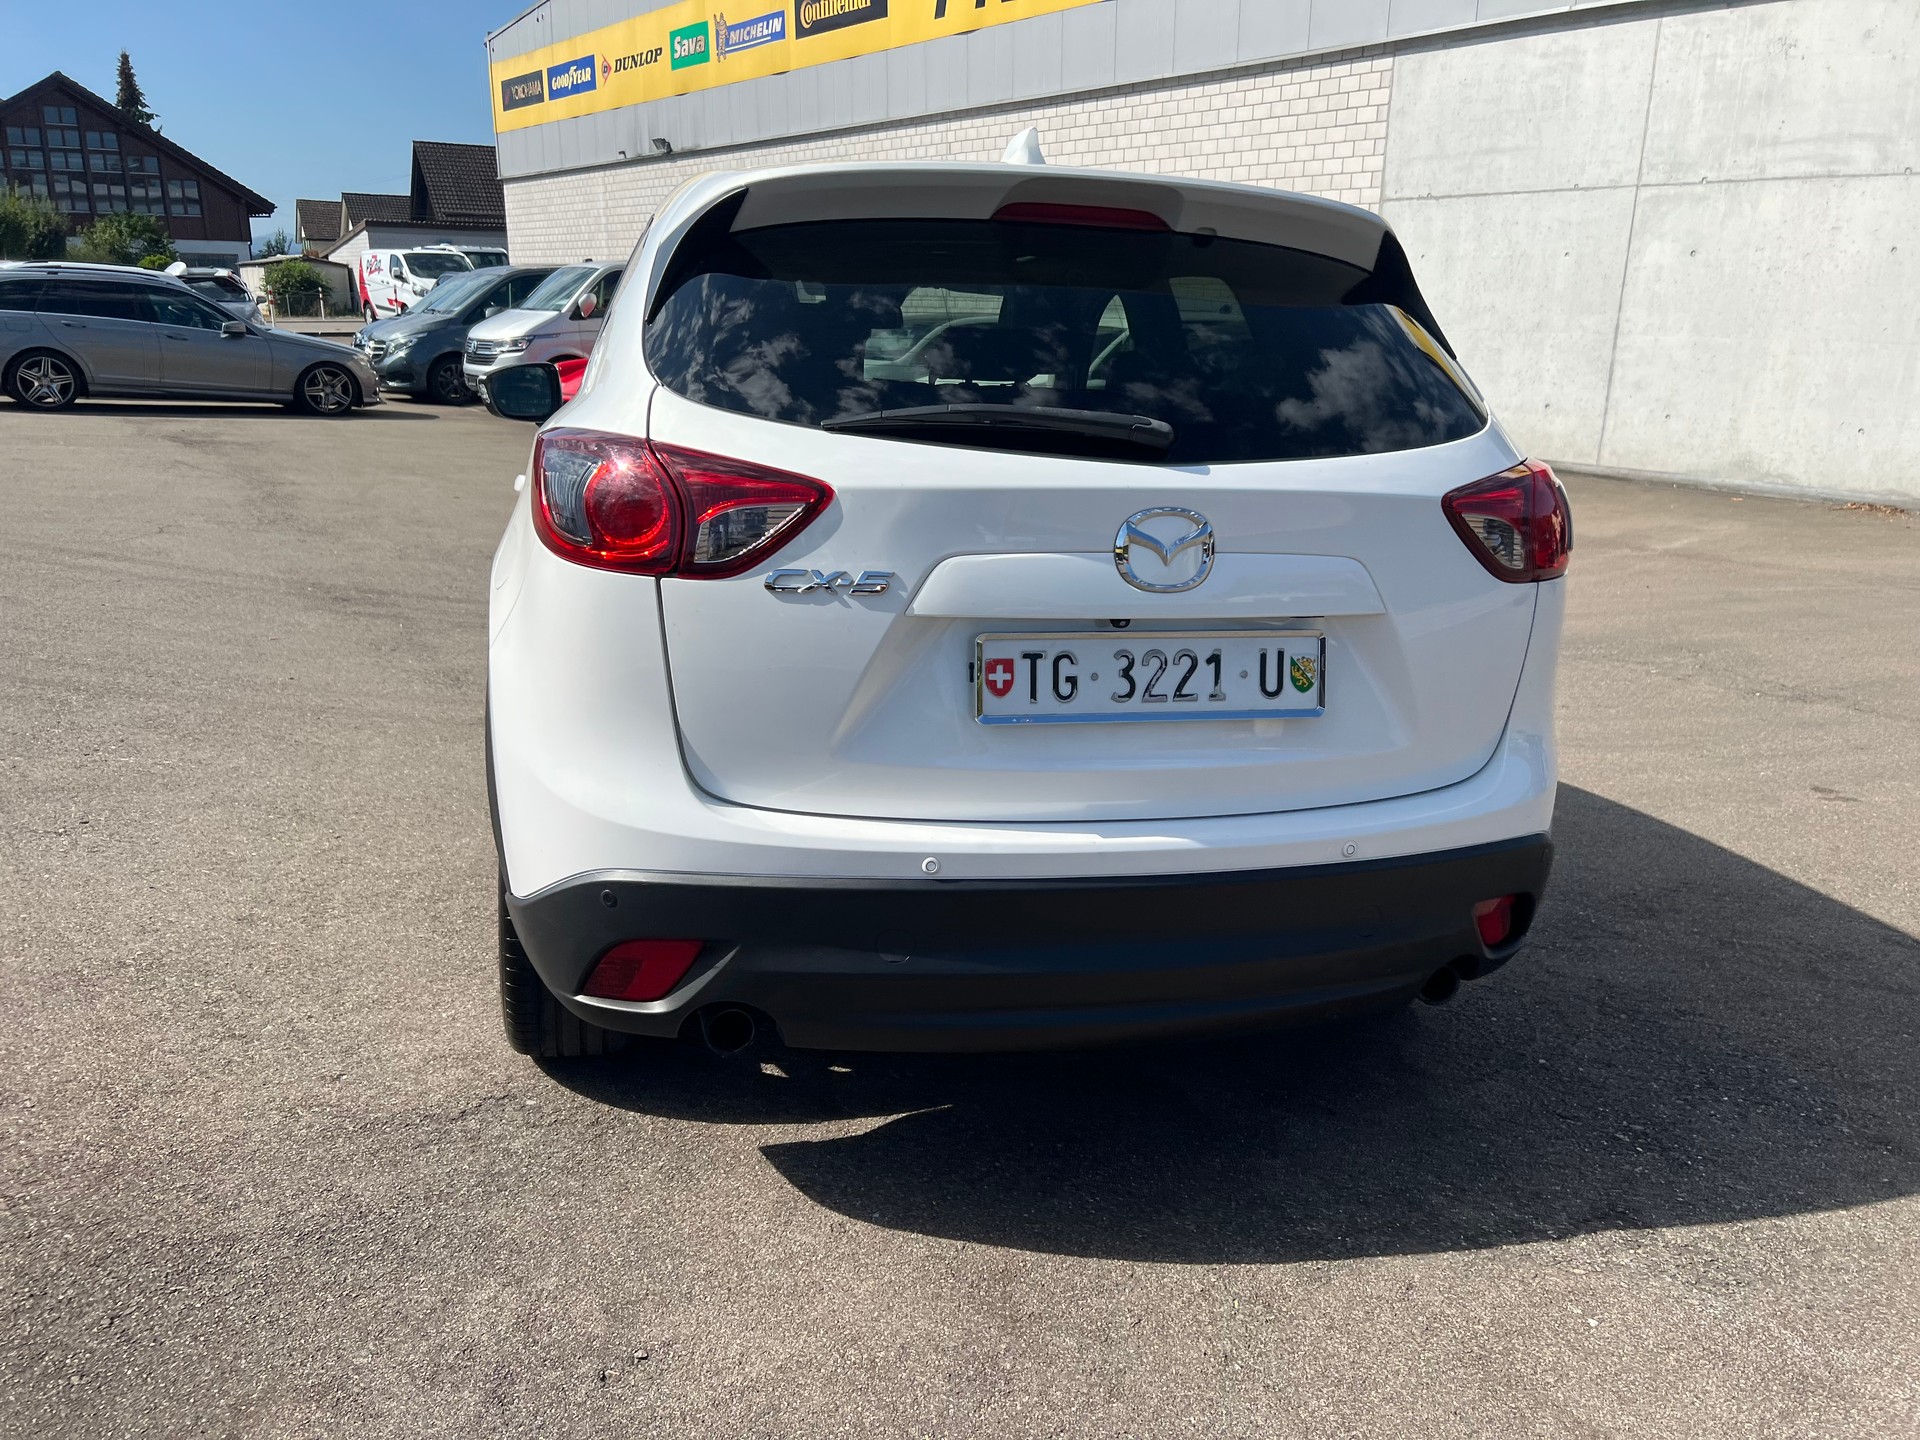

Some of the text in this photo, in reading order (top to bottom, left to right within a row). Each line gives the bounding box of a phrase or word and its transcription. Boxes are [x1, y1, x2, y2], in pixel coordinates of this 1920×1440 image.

[800, 0, 871, 29] Continen
[729, 16, 783, 45] MICHELIN
[613, 47, 663, 74] DUNLOP
[673, 34, 706, 60] Sava
[551, 65, 592, 91] GOODYEAR
[763, 568, 895, 596] CX-5
[1020, 648, 1286, 704] TG 3221 U
